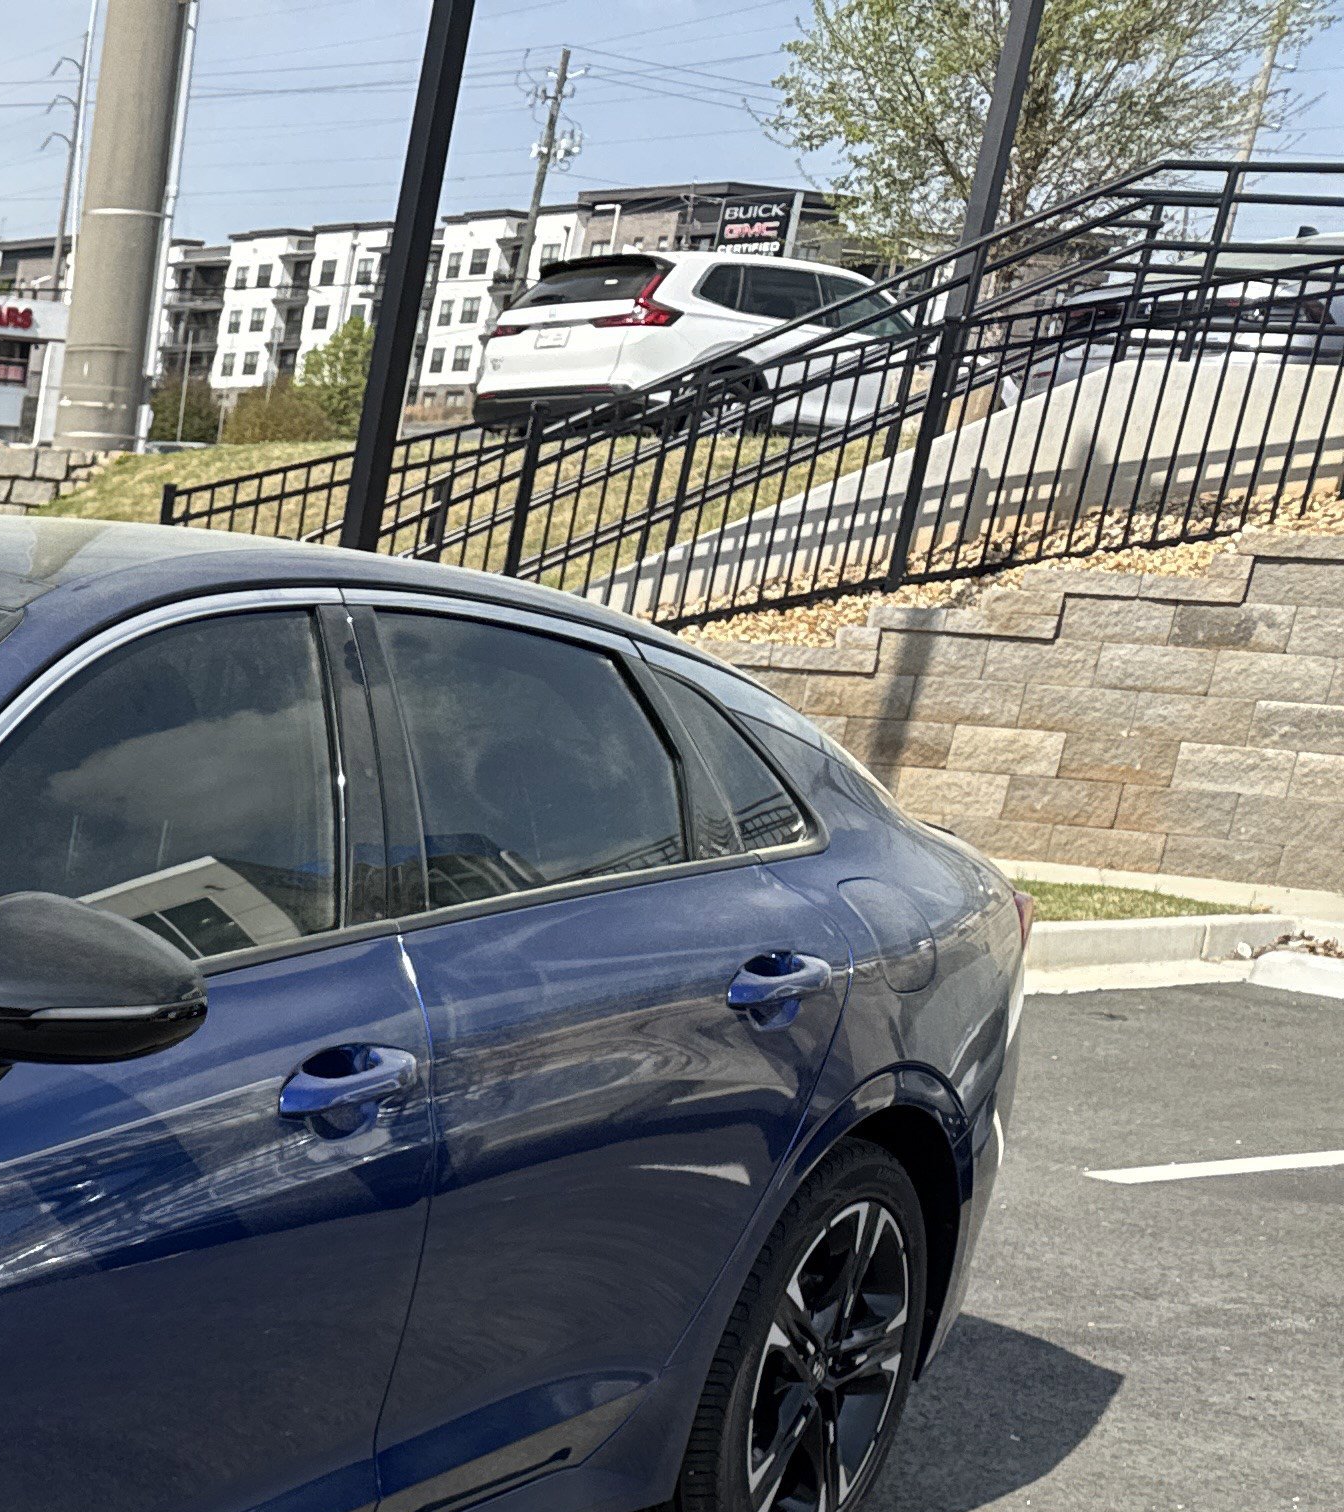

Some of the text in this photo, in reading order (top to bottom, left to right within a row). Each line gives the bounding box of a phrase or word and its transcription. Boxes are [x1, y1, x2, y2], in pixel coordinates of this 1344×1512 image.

[724, 203, 786, 220] BUICK
[724, 221, 780, 239] GMC
[717, 241, 780, 254] CERTIFIED
